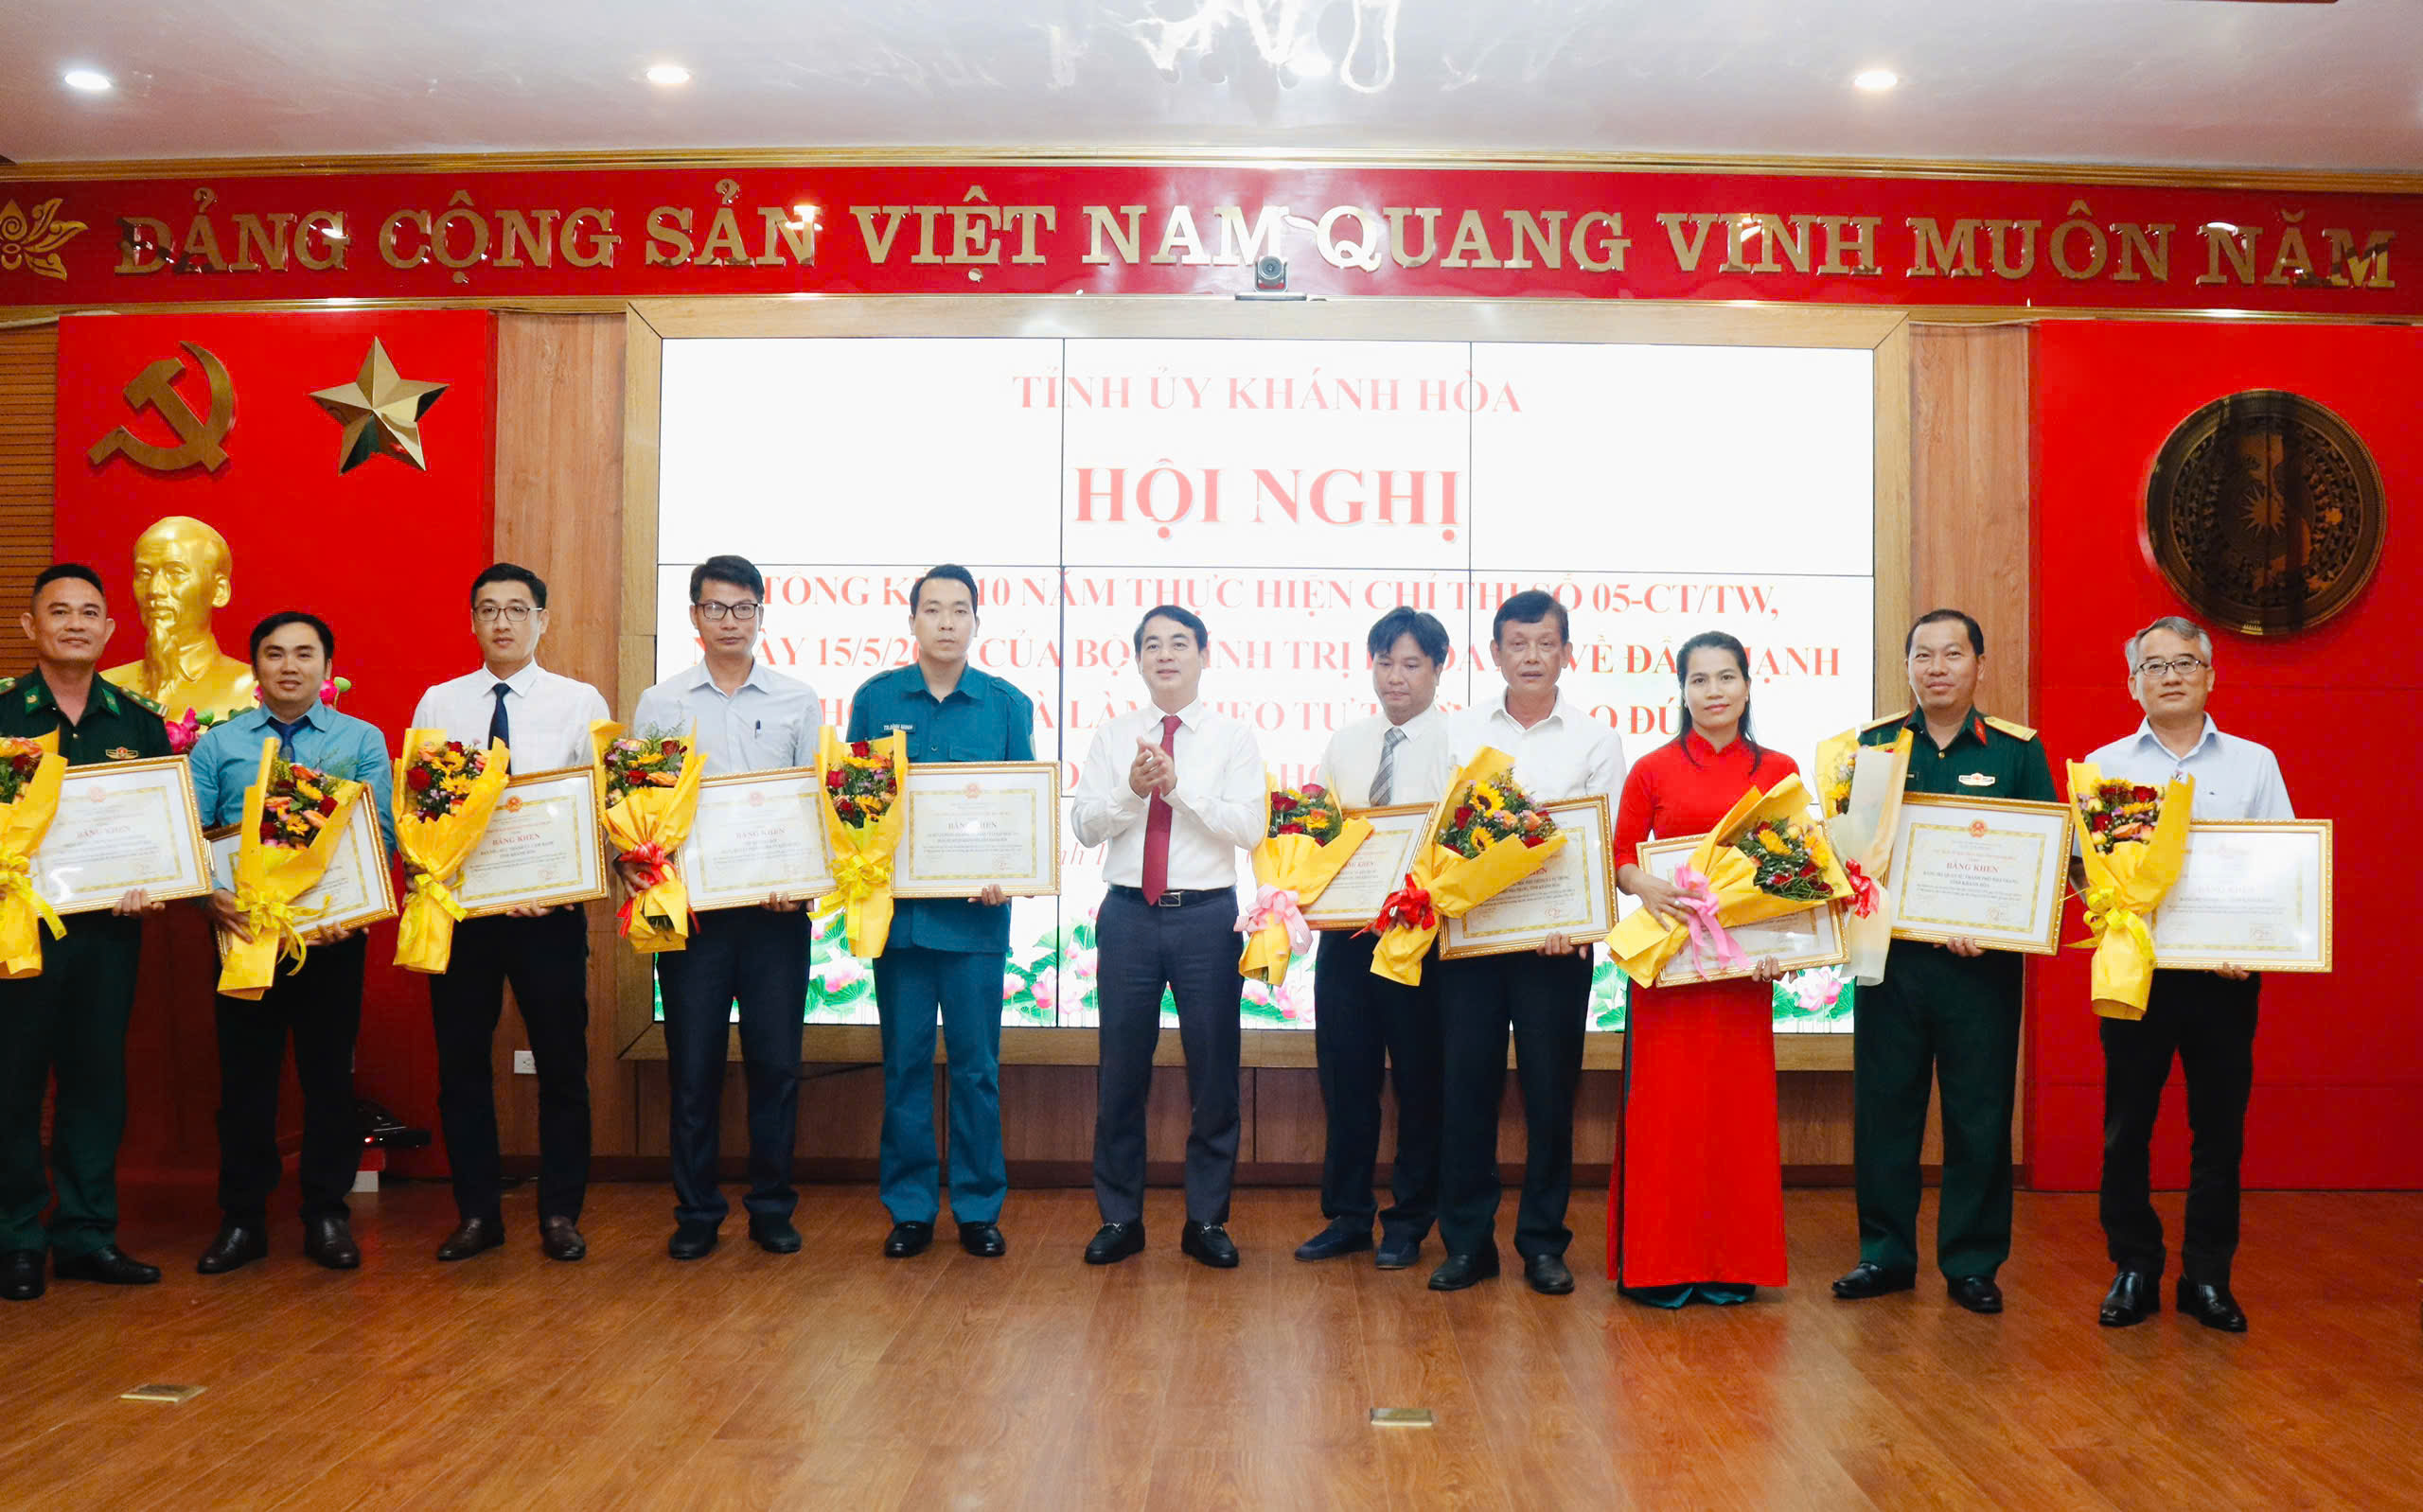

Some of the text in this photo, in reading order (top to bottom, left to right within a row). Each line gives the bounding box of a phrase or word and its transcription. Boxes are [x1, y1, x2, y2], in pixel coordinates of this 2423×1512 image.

[115, 178, 2397, 289] ĐẢNG CỘNG SẢN VIỆT NAM QUANG VINH MUÔN NĂM
[1013, 366, 1131, 409] TỈNH
[1228, 366, 1401, 412] KHÁNH
[1418, 370, 1523, 413] HÒA
[1074, 458, 1463, 542] HỘI NGHỊ
[1022, 570, 1114, 607] NĂM
[1126, 574, 1245, 616] THỰC
[1256, 574, 1353, 617] HIỆN
[1592, 583, 1779, 621] 05-CT/TW,
[979, 629, 1061, 668] CỦA
[1075, 634, 1131, 677] BỘ
[1283, 641, 1351, 678] TRỊ
[1748, 646, 1840, 683] ẠNH
